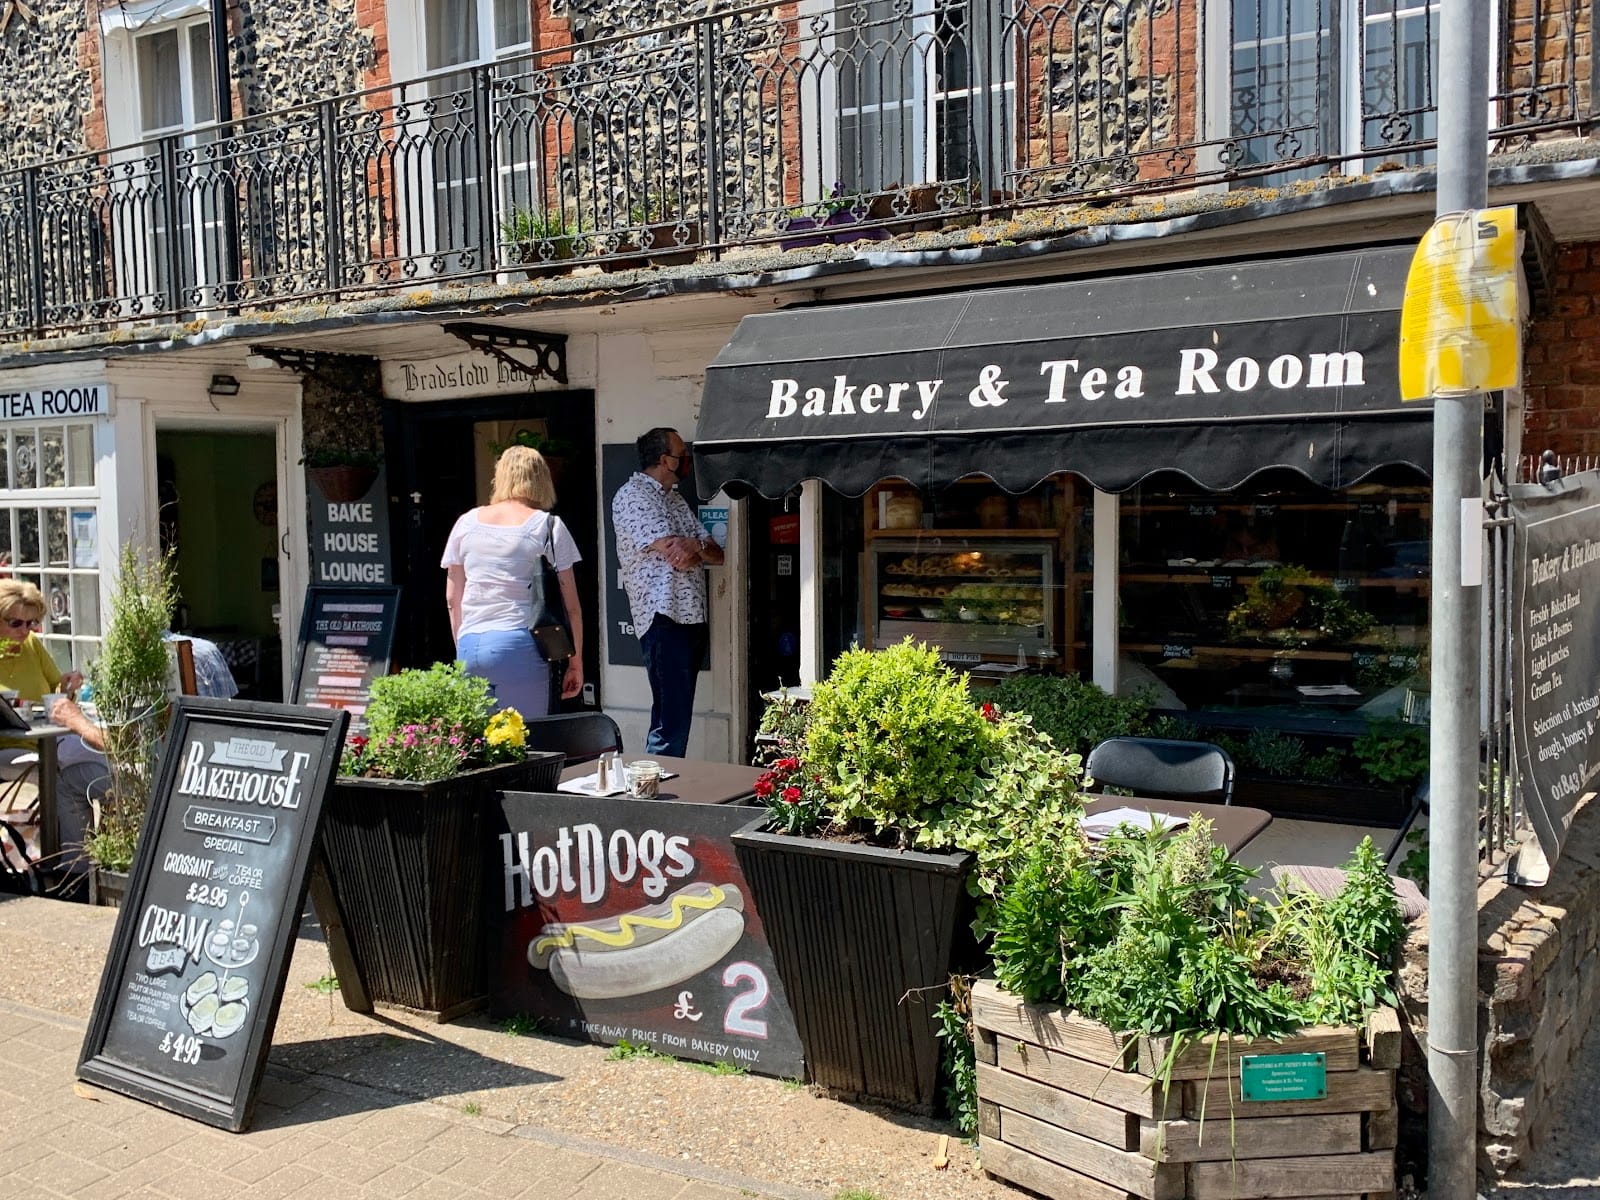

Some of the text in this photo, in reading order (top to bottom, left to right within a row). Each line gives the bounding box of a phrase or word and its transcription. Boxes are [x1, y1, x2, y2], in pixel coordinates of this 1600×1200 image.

[400, 362, 490, 392] Bradstow
[765, 347, 1366, 421] Bakery & Tea Room
[0, 387, 98, 418] TEA ROOM
[327, 503, 373, 522] BAKE
[701, 511, 728, 519] PLEAS
[323, 532, 379, 552] HOUSE
[320, 561, 385, 583] LOUNGE
[1531, 552, 1562, 586] Bakery
[1562, 546, 1570, 574] &
[1570, 543, 1584, 570] Tea
[1530, 588, 1581, 628] Freshly Baked Bread
[315, 620, 329, 631] THE
[342, 620, 384, 632] BAKEHOUSE
[618, 621, 634, 635] Te
[1530, 633, 1547, 652] Cakes
[1530, 644, 1570, 680] Light Lunches
[1530, 671, 1563, 701] Cream Tea
[1533, 711, 1563, 738] Selection
[1562, 703, 1572, 721] of
[1573, 694, 1600, 717] Artisan
[234, 742, 266, 756] THE OLD
[1538, 720, 1594, 762] dough, honey &
[178, 741, 310, 809] BAKEHOUSE
[1551, 773, 1581, 801] 01843
[194, 812, 260, 833] BREAKFAST
[203, 836, 245, 855] SPECIAL
[163, 851, 215, 880] CROSSANT
[235, 864, 251, 877] TEA
[252, 867, 263, 879] OR
[185, 882, 229, 908] £2.95
[228, 874, 263, 890] COFFEE
[138, 904, 209, 961] CREAM
[151, 951, 175, 966] TEA
[135, 973, 149, 984] TWO
[673, 961, 769, 1039] £ 2
[127, 1010, 137, 1021] TEA
[580, 1019, 760, 1063] TAKE AWAY PRICE FROM BAKERY ONLY.
